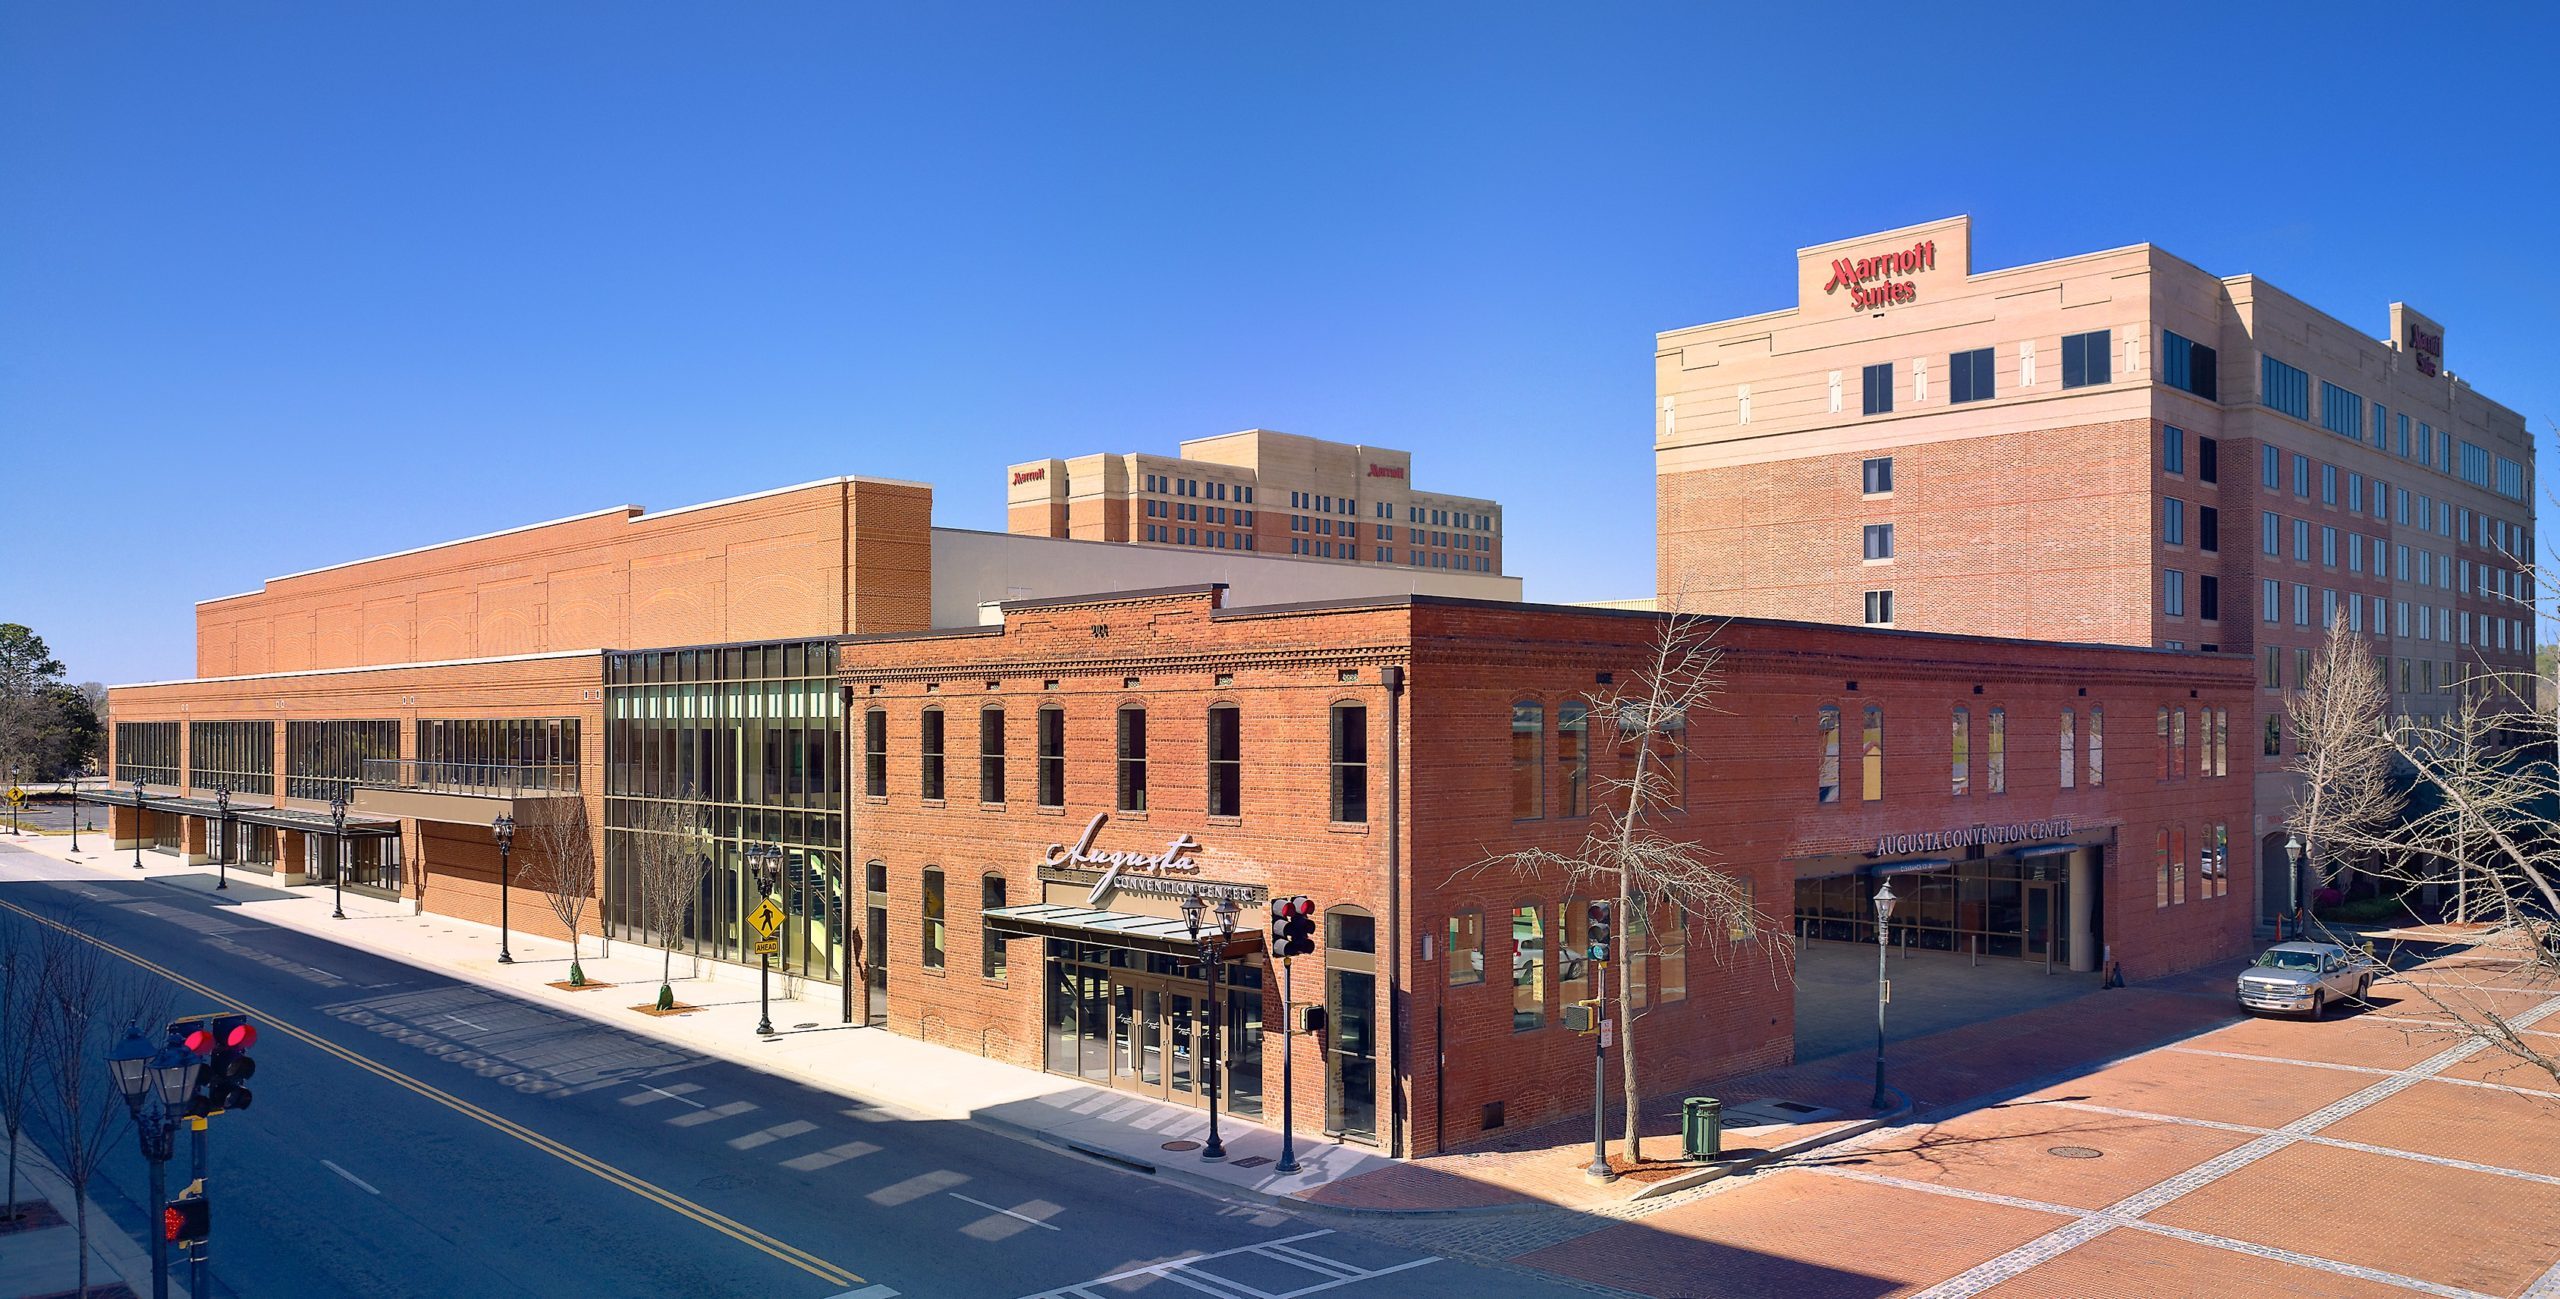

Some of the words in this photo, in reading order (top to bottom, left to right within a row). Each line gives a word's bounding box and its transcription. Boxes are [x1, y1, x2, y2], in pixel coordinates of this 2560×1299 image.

[1824, 240, 1935, 292] Marriott
[1851, 279, 1915, 310] Suites
[1012, 467, 1045, 486] Marriott
[1877, 832, 1941, 856] AUGUSTA
[1943, 824, 2028, 848] CONVENTION
[2030, 820, 2074, 841] CENTER
[1046, 812, 1202, 905] Augusta
[1113, 875, 1194, 896] CONVENTION
[1199, 883, 1252, 901] CENTER
[756, 943, 777, 952] AHEAD
